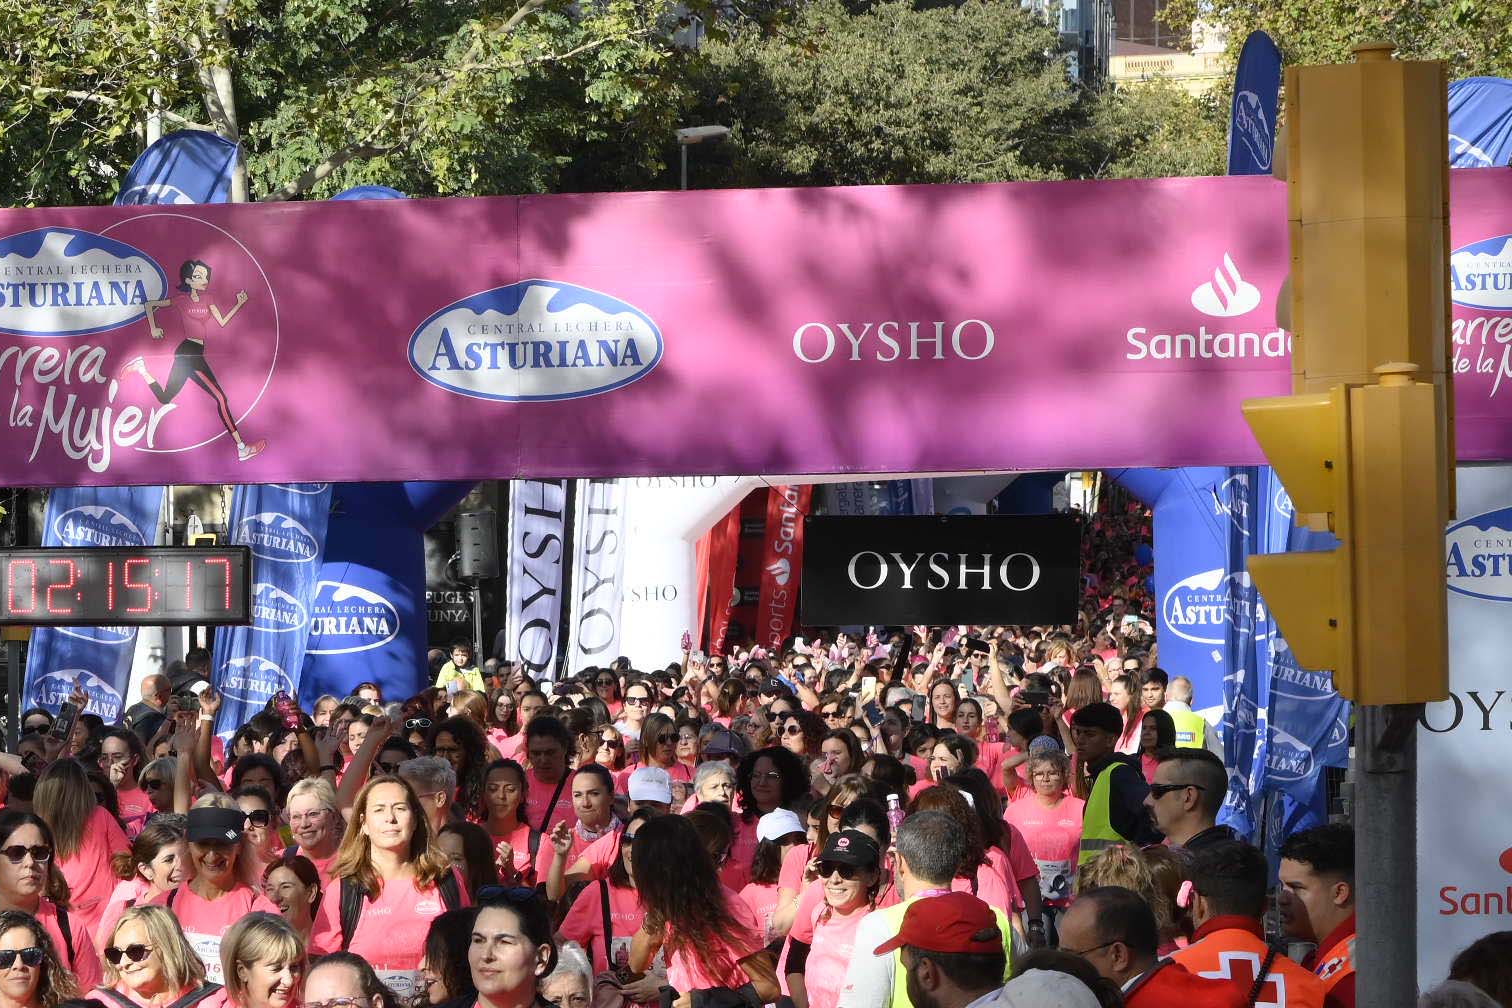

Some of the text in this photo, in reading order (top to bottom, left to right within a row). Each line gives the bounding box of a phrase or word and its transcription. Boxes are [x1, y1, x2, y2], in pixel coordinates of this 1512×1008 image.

[71, 263, 143, 275] LECHERA
[468, 319, 635, 336] CENTRAL LECHERA
[791, 318, 996, 364] OYSHO
[428, 327, 644, 371] ASTURIANA
[1126, 326, 1294, 361] Santand
[1476, 346, 1495, 375] la
[9, 388, 33, 428] la
[29, 379, 178, 473] Mujer
[847, 550, 1041, 592] OYSHO
[7, 558, 231, 614] 02:15:17
[253, 603, 300, 627] URIANA
[310, 617, 391, 636] URIANA
[1272, 664, 1332, 693] URIANA
[206, 963, 221, 973] 16
